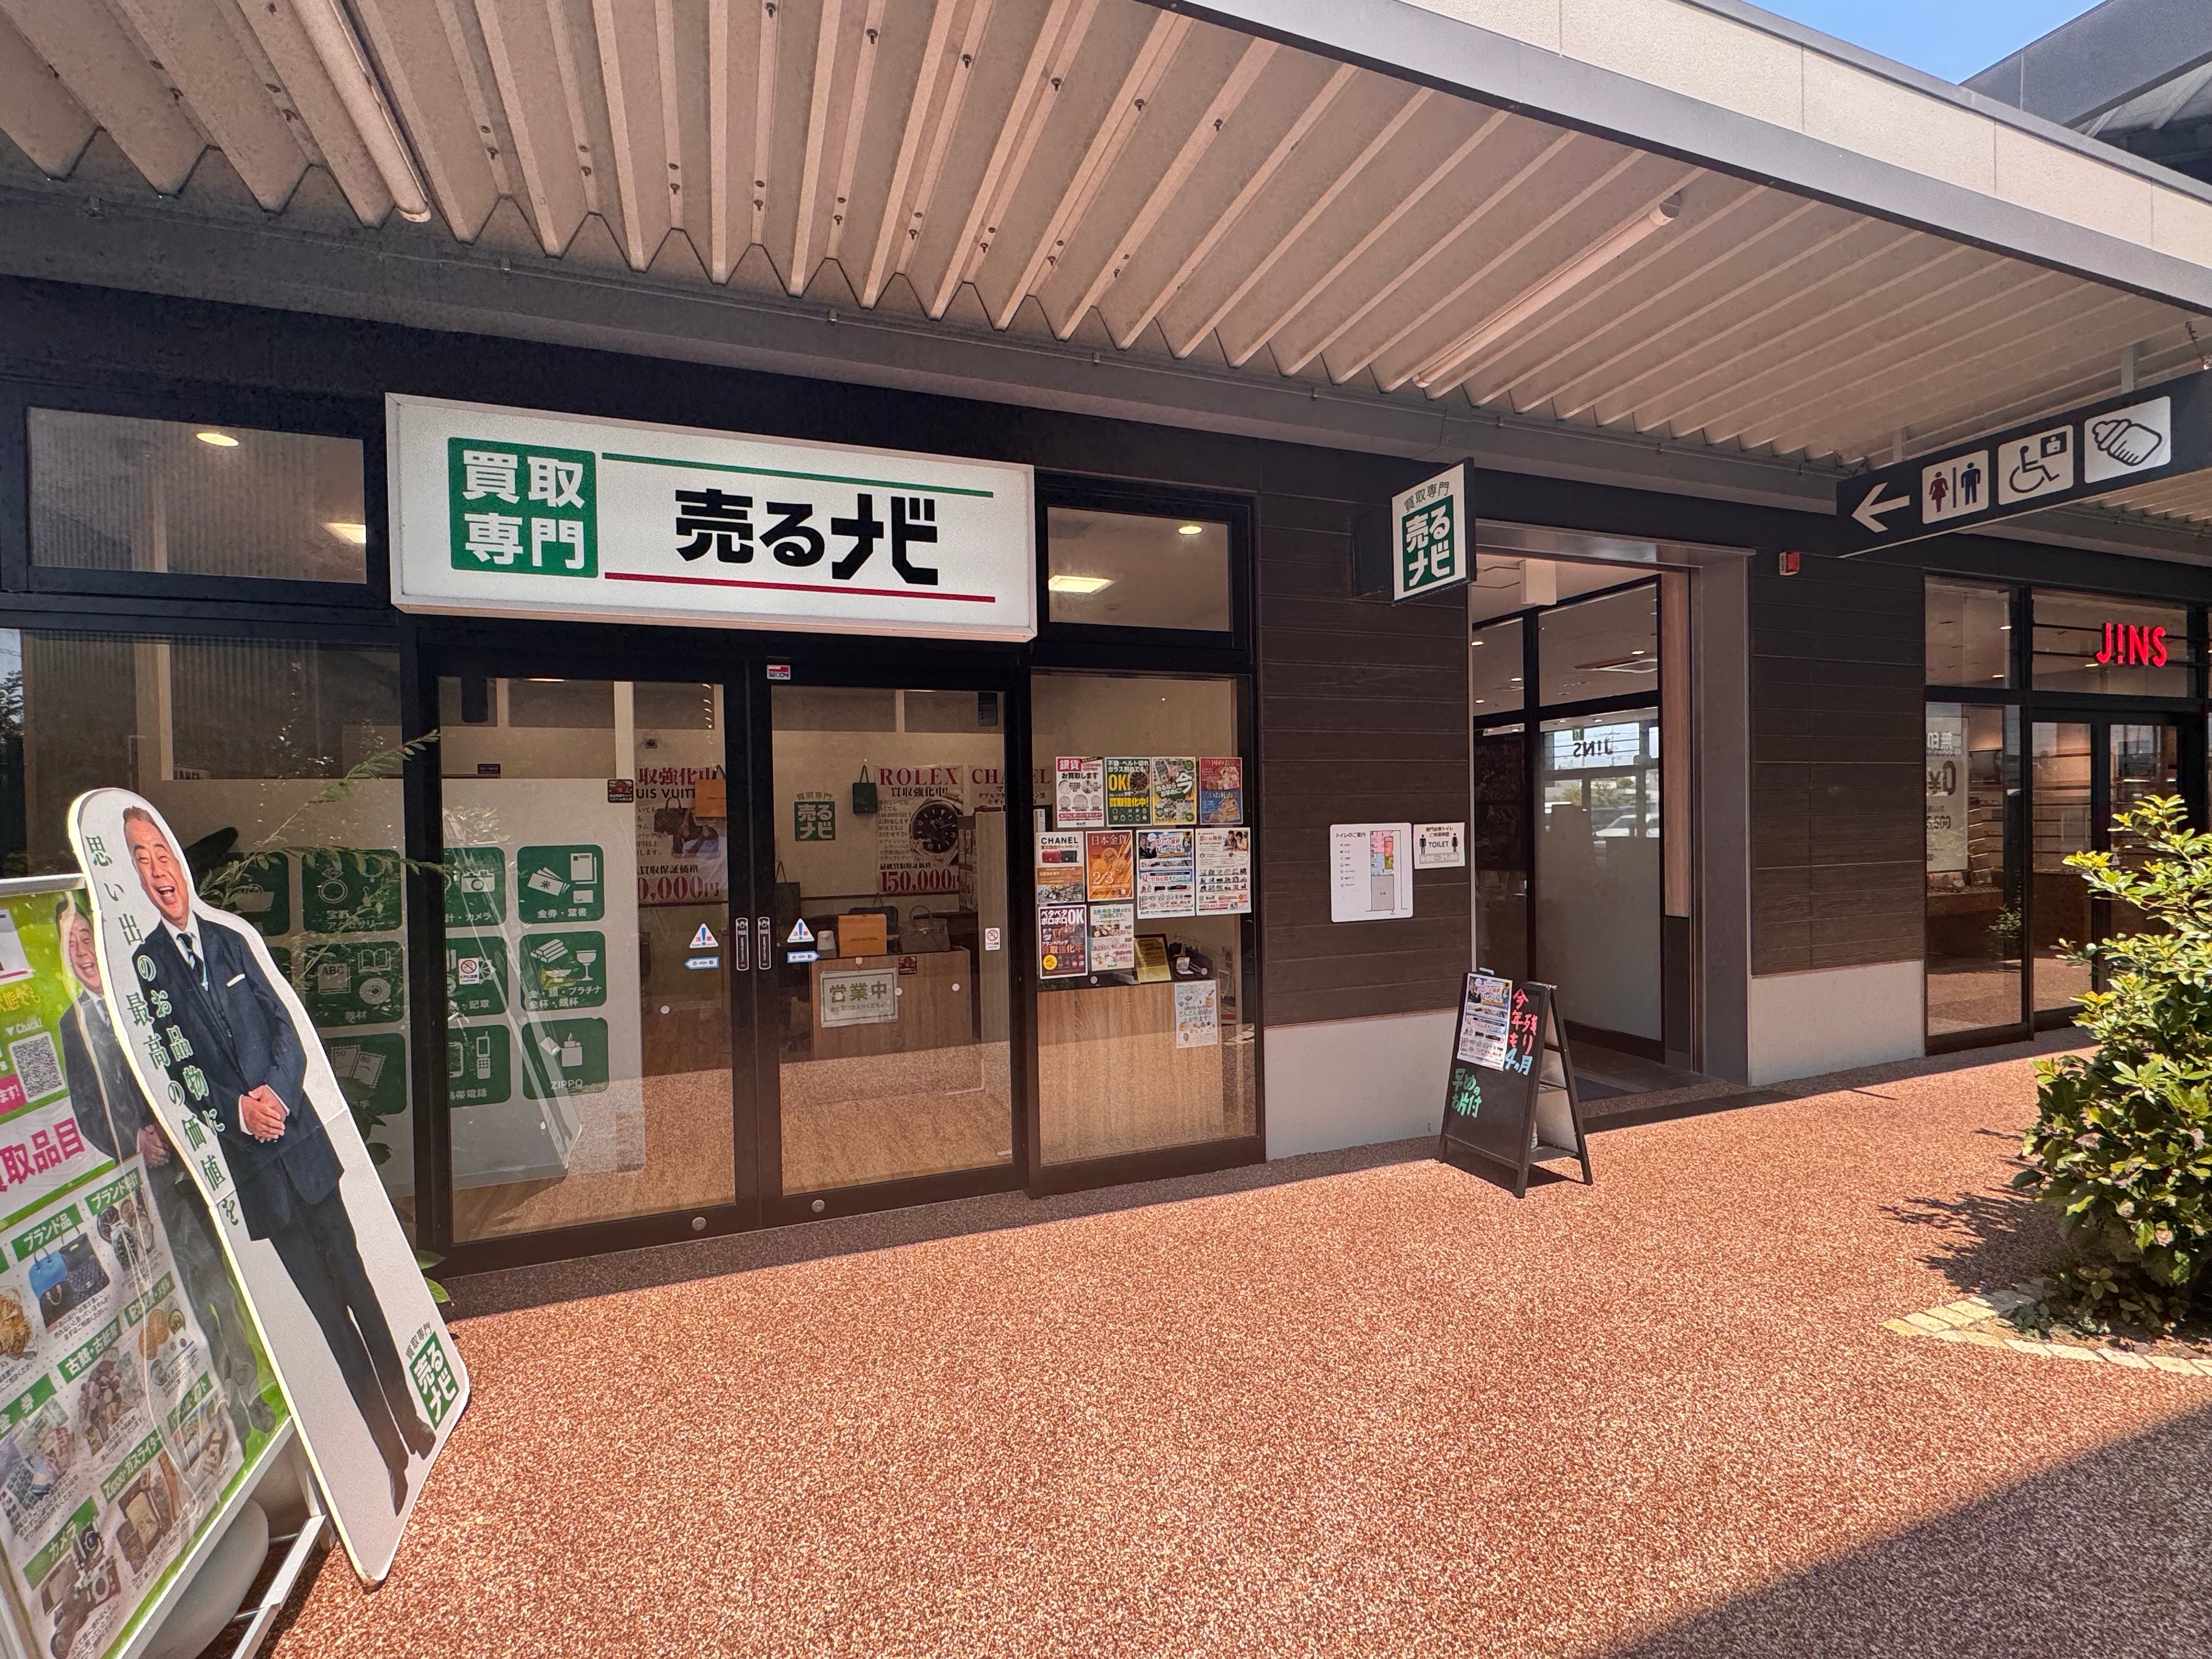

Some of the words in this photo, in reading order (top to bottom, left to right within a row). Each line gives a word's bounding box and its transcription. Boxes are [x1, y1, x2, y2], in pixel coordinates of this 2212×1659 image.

[462, 449, 585, 510] 買取
[1404, 482, 1449, 513] 買取専門
[465, 512, 586, 571] 専門
[675, 489, 939, 586] 売るナビ
[1406, 505, 1450, 553] 売る
[1409, 539, 1450, 587] ナビ
[879, 768, 958, 786] ROLEX
[1176, 772, 1193, 794] 今
[796, 791, 832, 801] 買取専門
[798, 804, 833, 822] 売る
[799, 823, 833, 839] ナビ
[637, 865, 698, 875] 買取保証価格
[1068, 909, 1084, 924] OK
[322, 964, 343, 974] ABC
[830, 981, 887, 1003] 営業中
[550, 1078, 583, 1090] ZIPPO
[0, 1117, 85, 1192] 取品目
[24, 1212, 73, 1251] ブランド品
[406, 1322, 432, 1361] 買取専門
[414, 1341, 443, 1394] 売る
[430, 1367, 457, 1423] ナビ
[48, 1520, 77, 1562] カメラ
